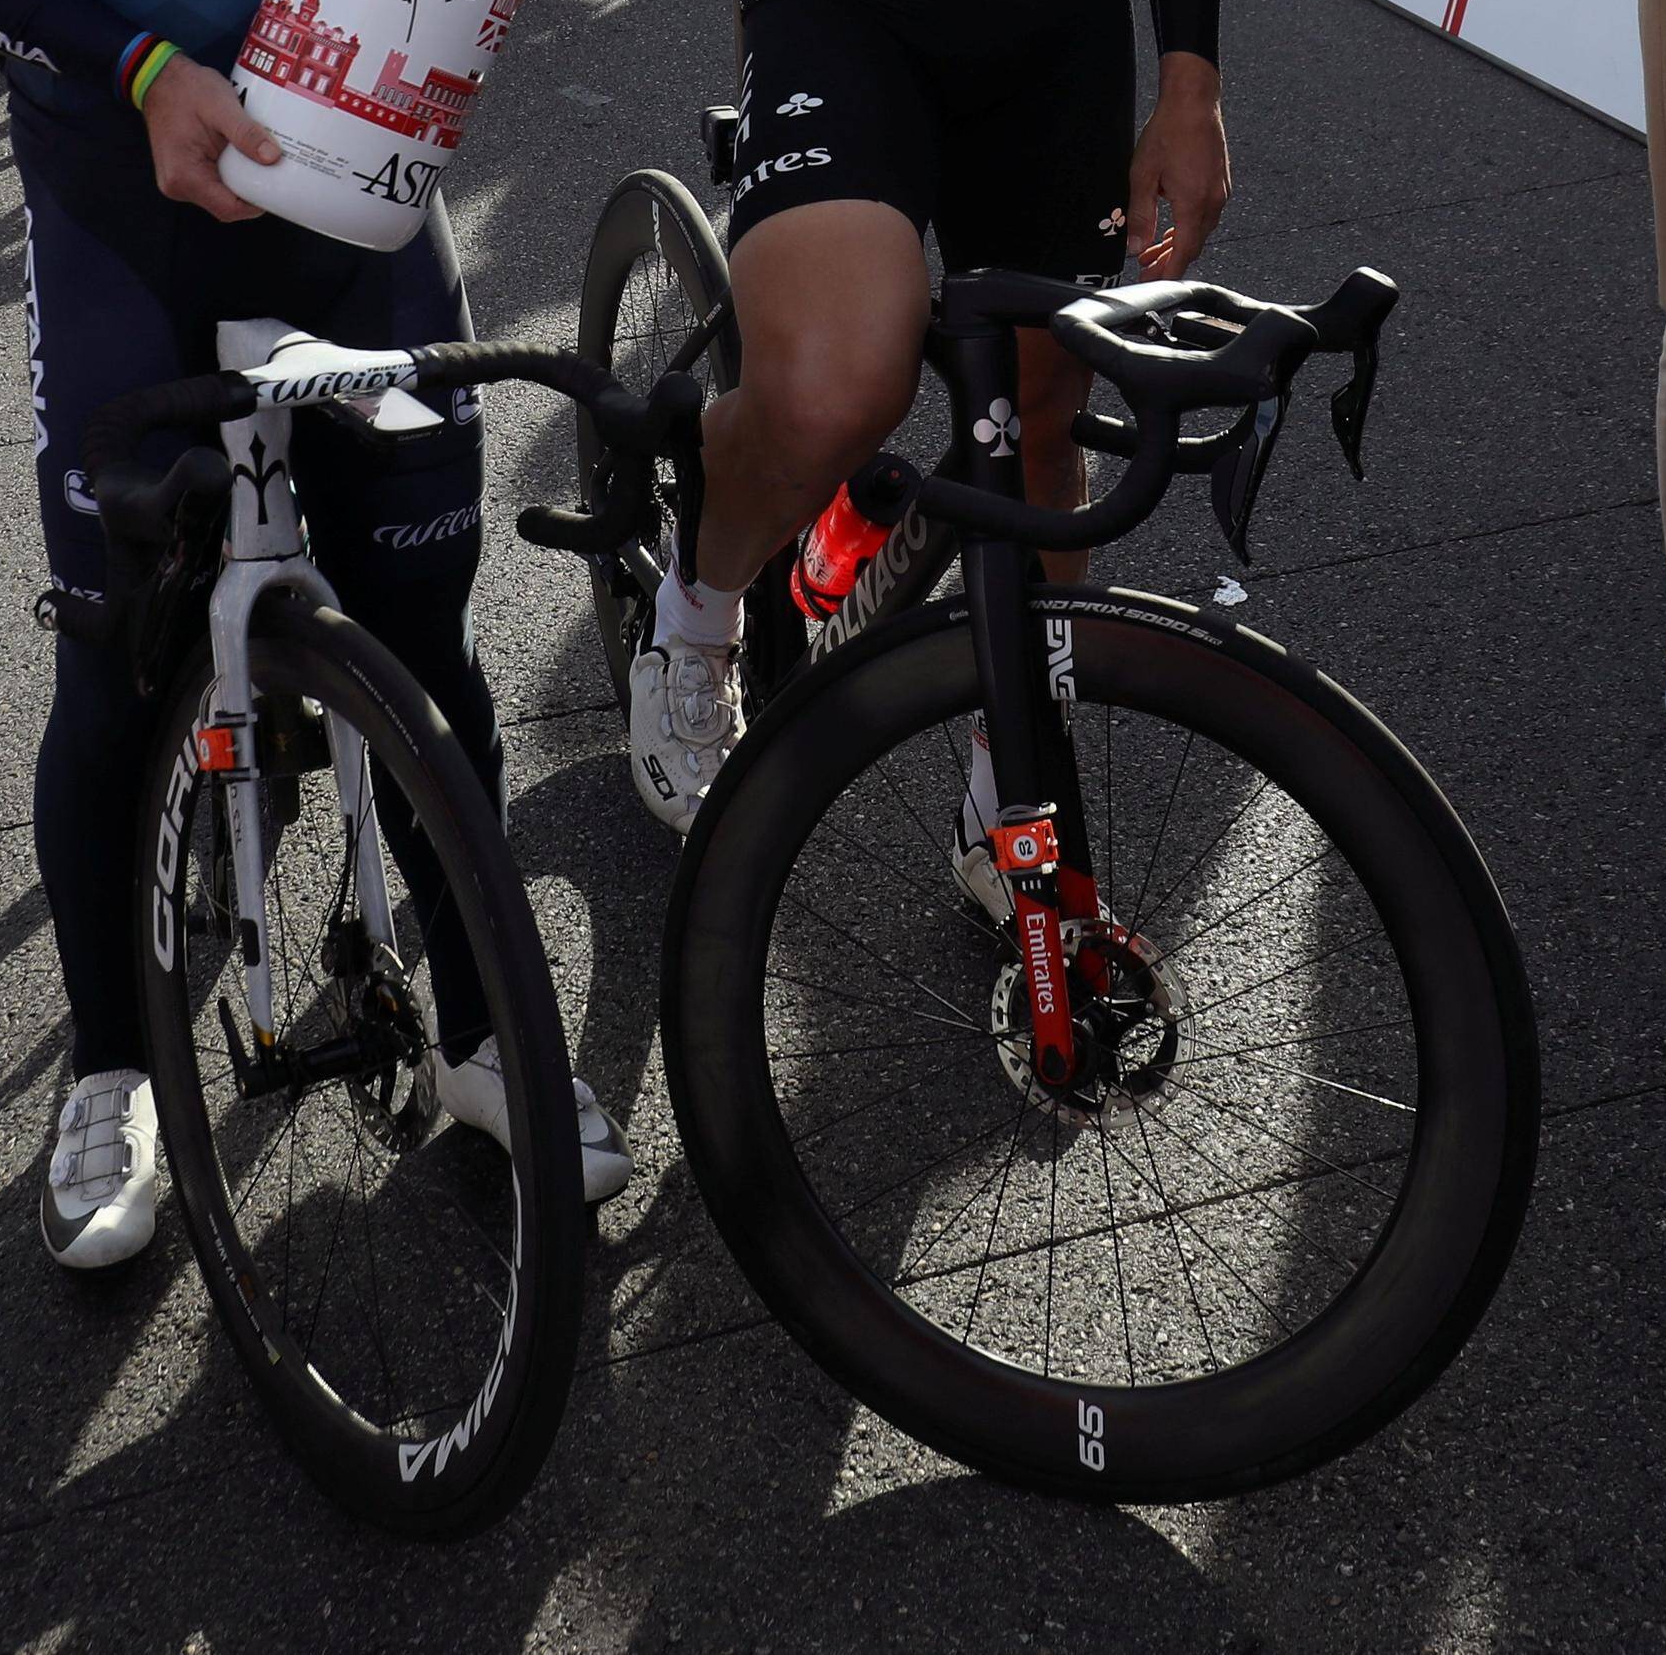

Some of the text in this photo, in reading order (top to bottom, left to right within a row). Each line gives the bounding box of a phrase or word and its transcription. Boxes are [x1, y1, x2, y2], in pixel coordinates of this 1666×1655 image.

[253, 368, 418, 403] Wilier
[1067, 600, 1125, 618] PRIX
[1128, 609, 1190, 634] 5000
[1018, 839, 1034, 858] 02
[1025, 911, 1056, 1015] Emirates
